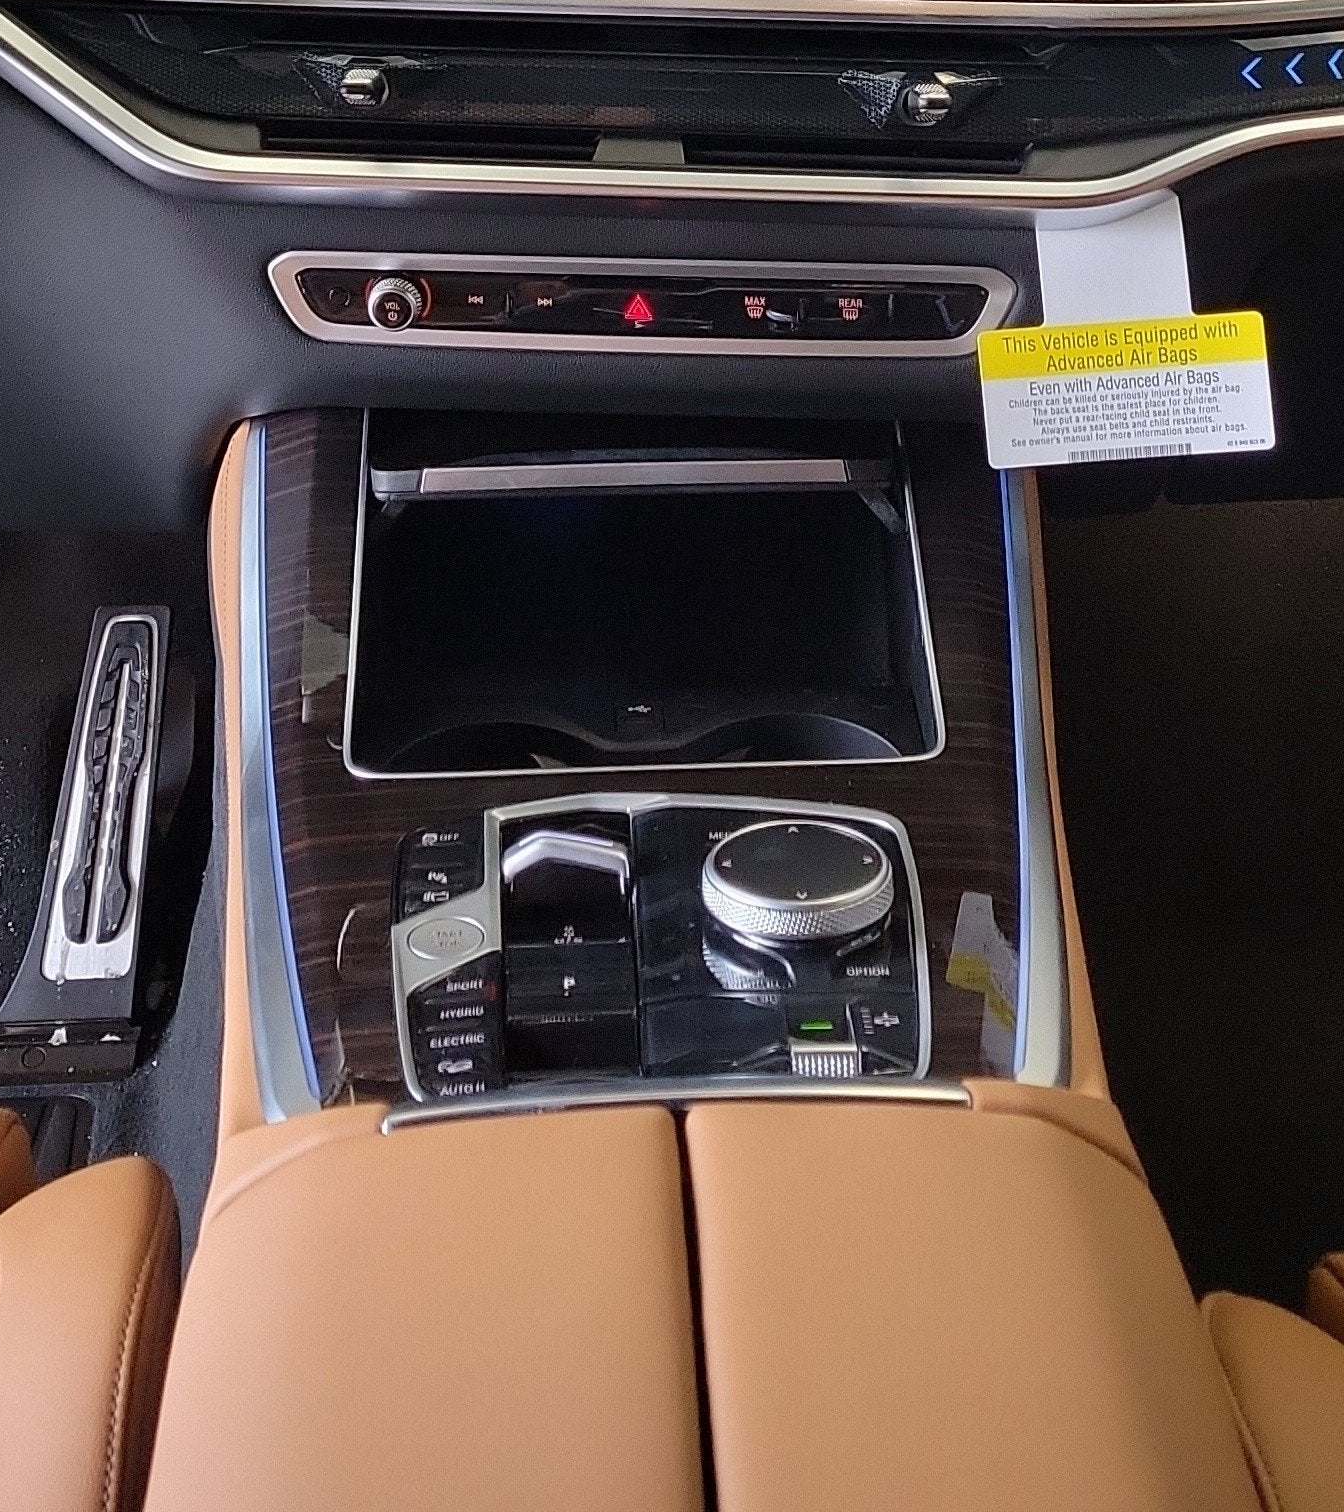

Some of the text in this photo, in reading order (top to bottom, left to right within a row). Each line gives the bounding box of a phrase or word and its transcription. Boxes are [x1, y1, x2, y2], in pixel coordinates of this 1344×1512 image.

[384, 301, 401, 311] VOL
[744, 296, 766, 306] MAX
[838, 298, 863, 309] REAR
[1002, 320, 1238, 354] This Vehicle is Equipped with
[1047, 347, 1198, 372] Advanced Air Bags
[1029, 370, 1220, 396] Even with Advanced Air Bags
[1008, 384, 1244, 409] Children can be killed or seriously injured by the air bag.
[1033, 396, 1220, 416] The back seat is the safest place for children.
[1033, 417, 1057, 427] Never
[1059, 416, 1073, 426] put
[1082, 412, 1127, 422] rear-facing
[1129, 410, 1150, 419] child
[1153, 408, 1170, 417] seat
[1172, 408, 1181, 416] in
[1183, 406, 1196, 415] the
[1199, 405, 1222, 414] front.
[1041, 414, 1215, 436] Always use seat belts and child restraints.
[1011, 422, 1247, 447] See owner's manual for more information about air bags.
[846, 965, 890, 977] OPTION
[445, 977, 484, 992] SPORT
[439, 1005, 485, 1020] HYBRID
[429, 1032, 485, 1049] ELECTRIC
[439, 1083, 474, 1097] AUTO
